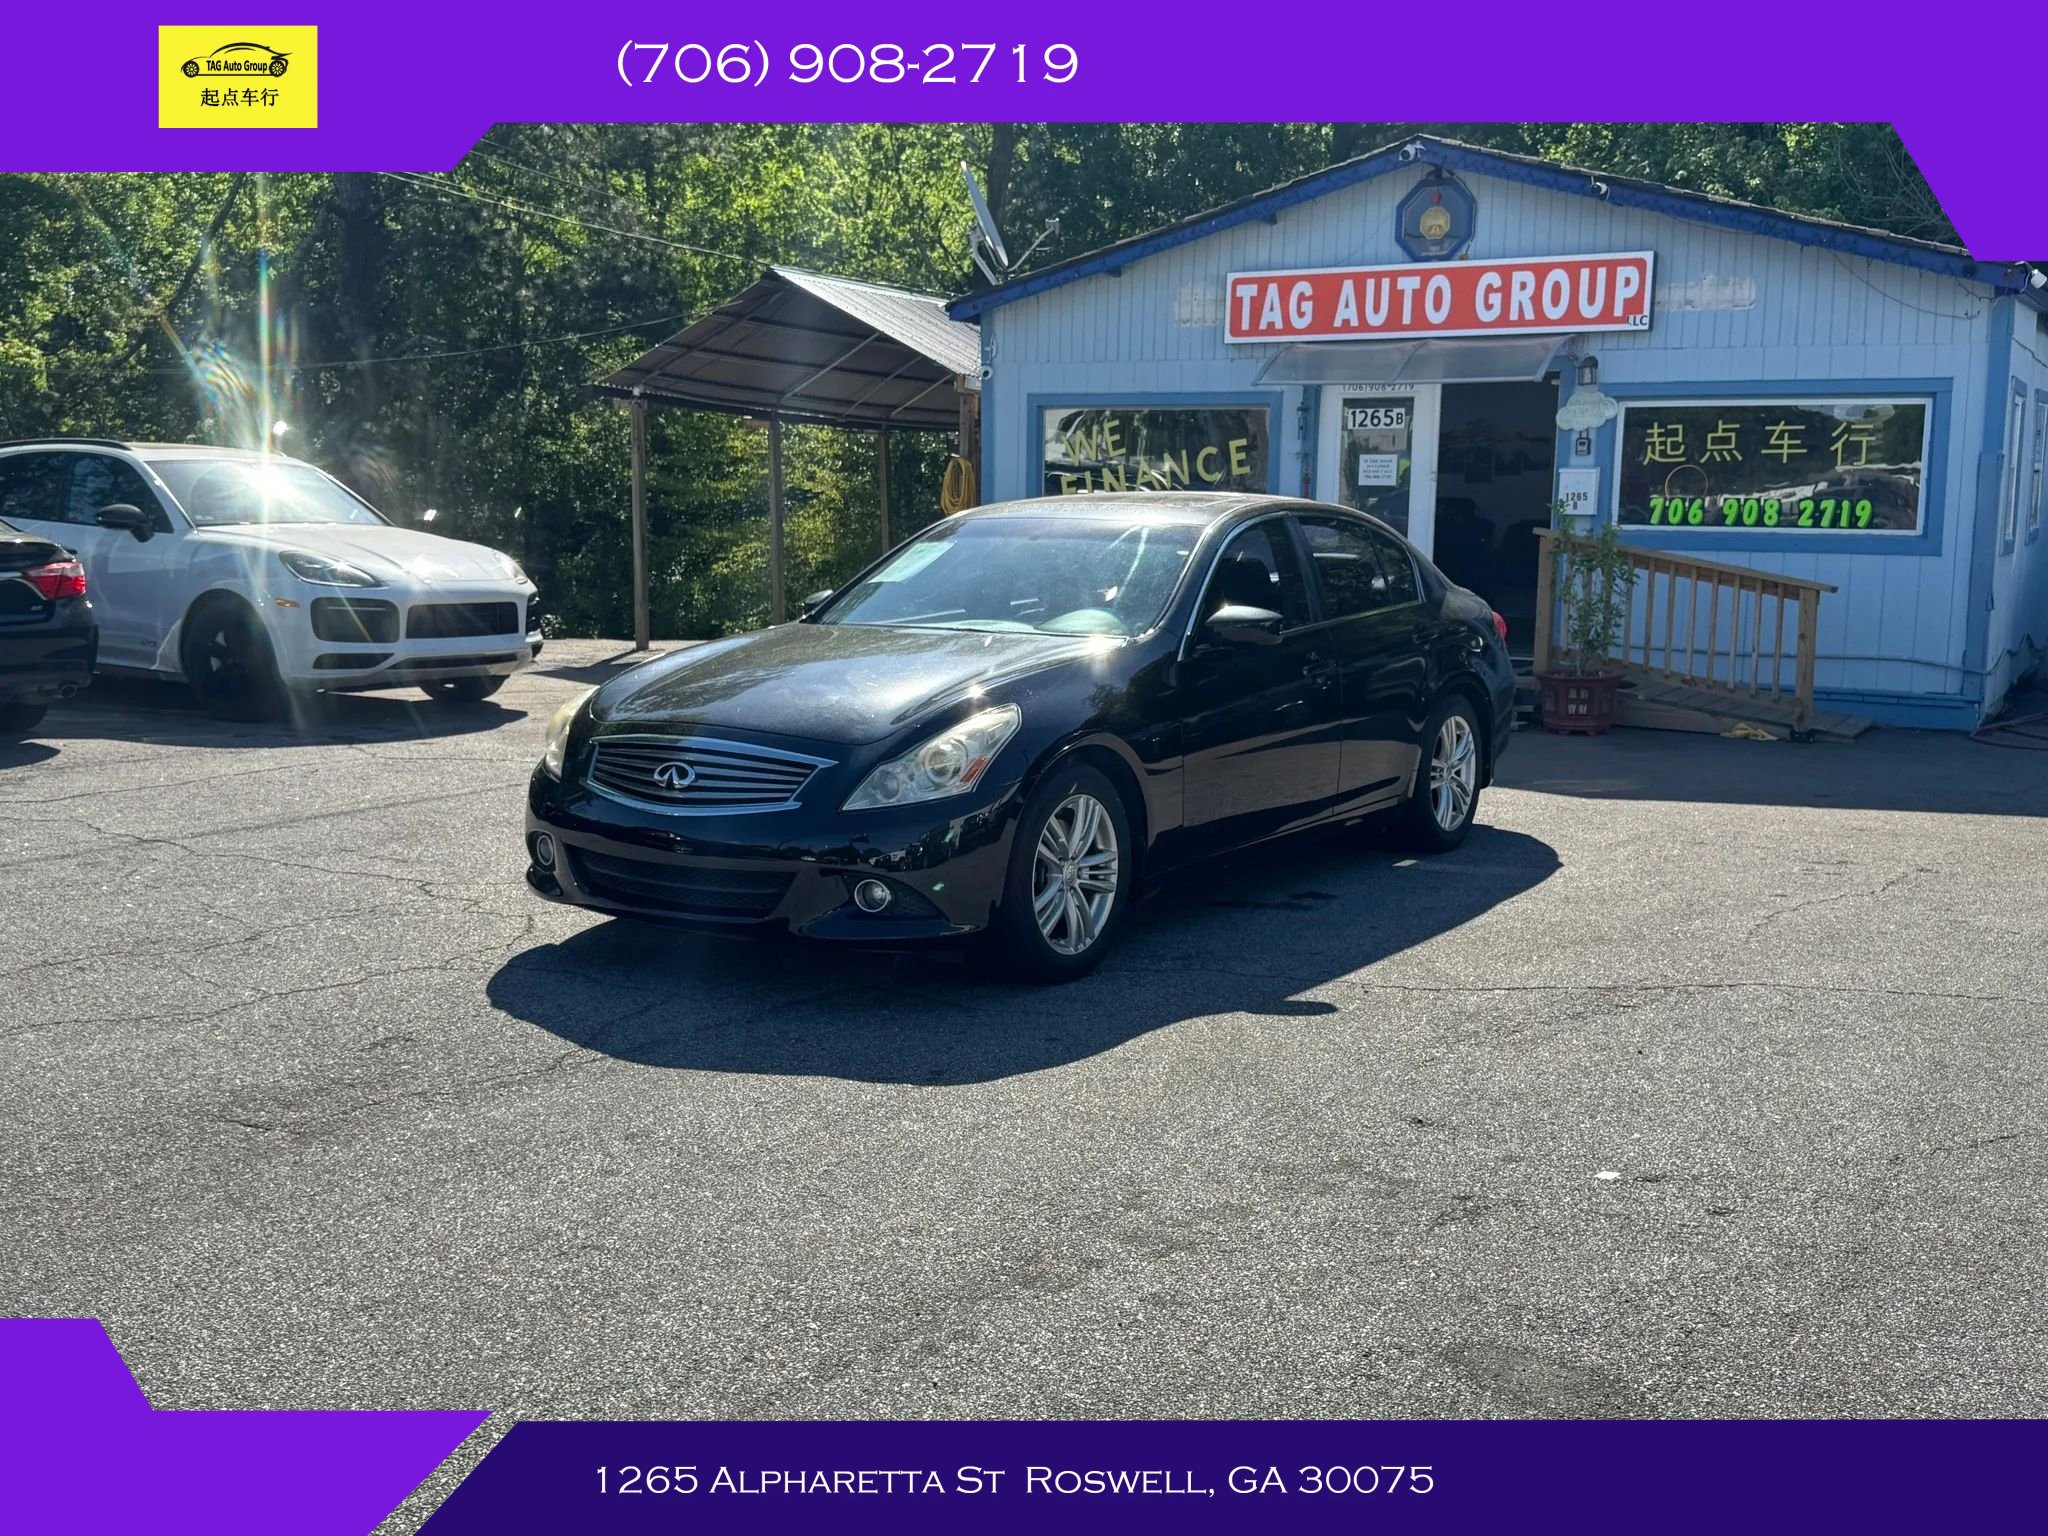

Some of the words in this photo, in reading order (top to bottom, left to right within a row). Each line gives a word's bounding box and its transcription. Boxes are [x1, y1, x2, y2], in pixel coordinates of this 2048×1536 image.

[1235, 280, 1314, 331] TAG
[1333, 273, 1452, 327] AUTO
[1475, 265, 1640, 323] GROUP
[1626, 314, 1649, 327] LLC
[1061, 438, 1251, 495] FINANCE
[1062, 419, 1127, 467] WE
[1642, 420, 1878, 467] 起点车行
[1565, 492, 1589, 502] 1265
[1650, 498, 1705, 526] 706
[1722, 498, 1780, 527] 908
[1797, 499, 1873, 528] 2719
